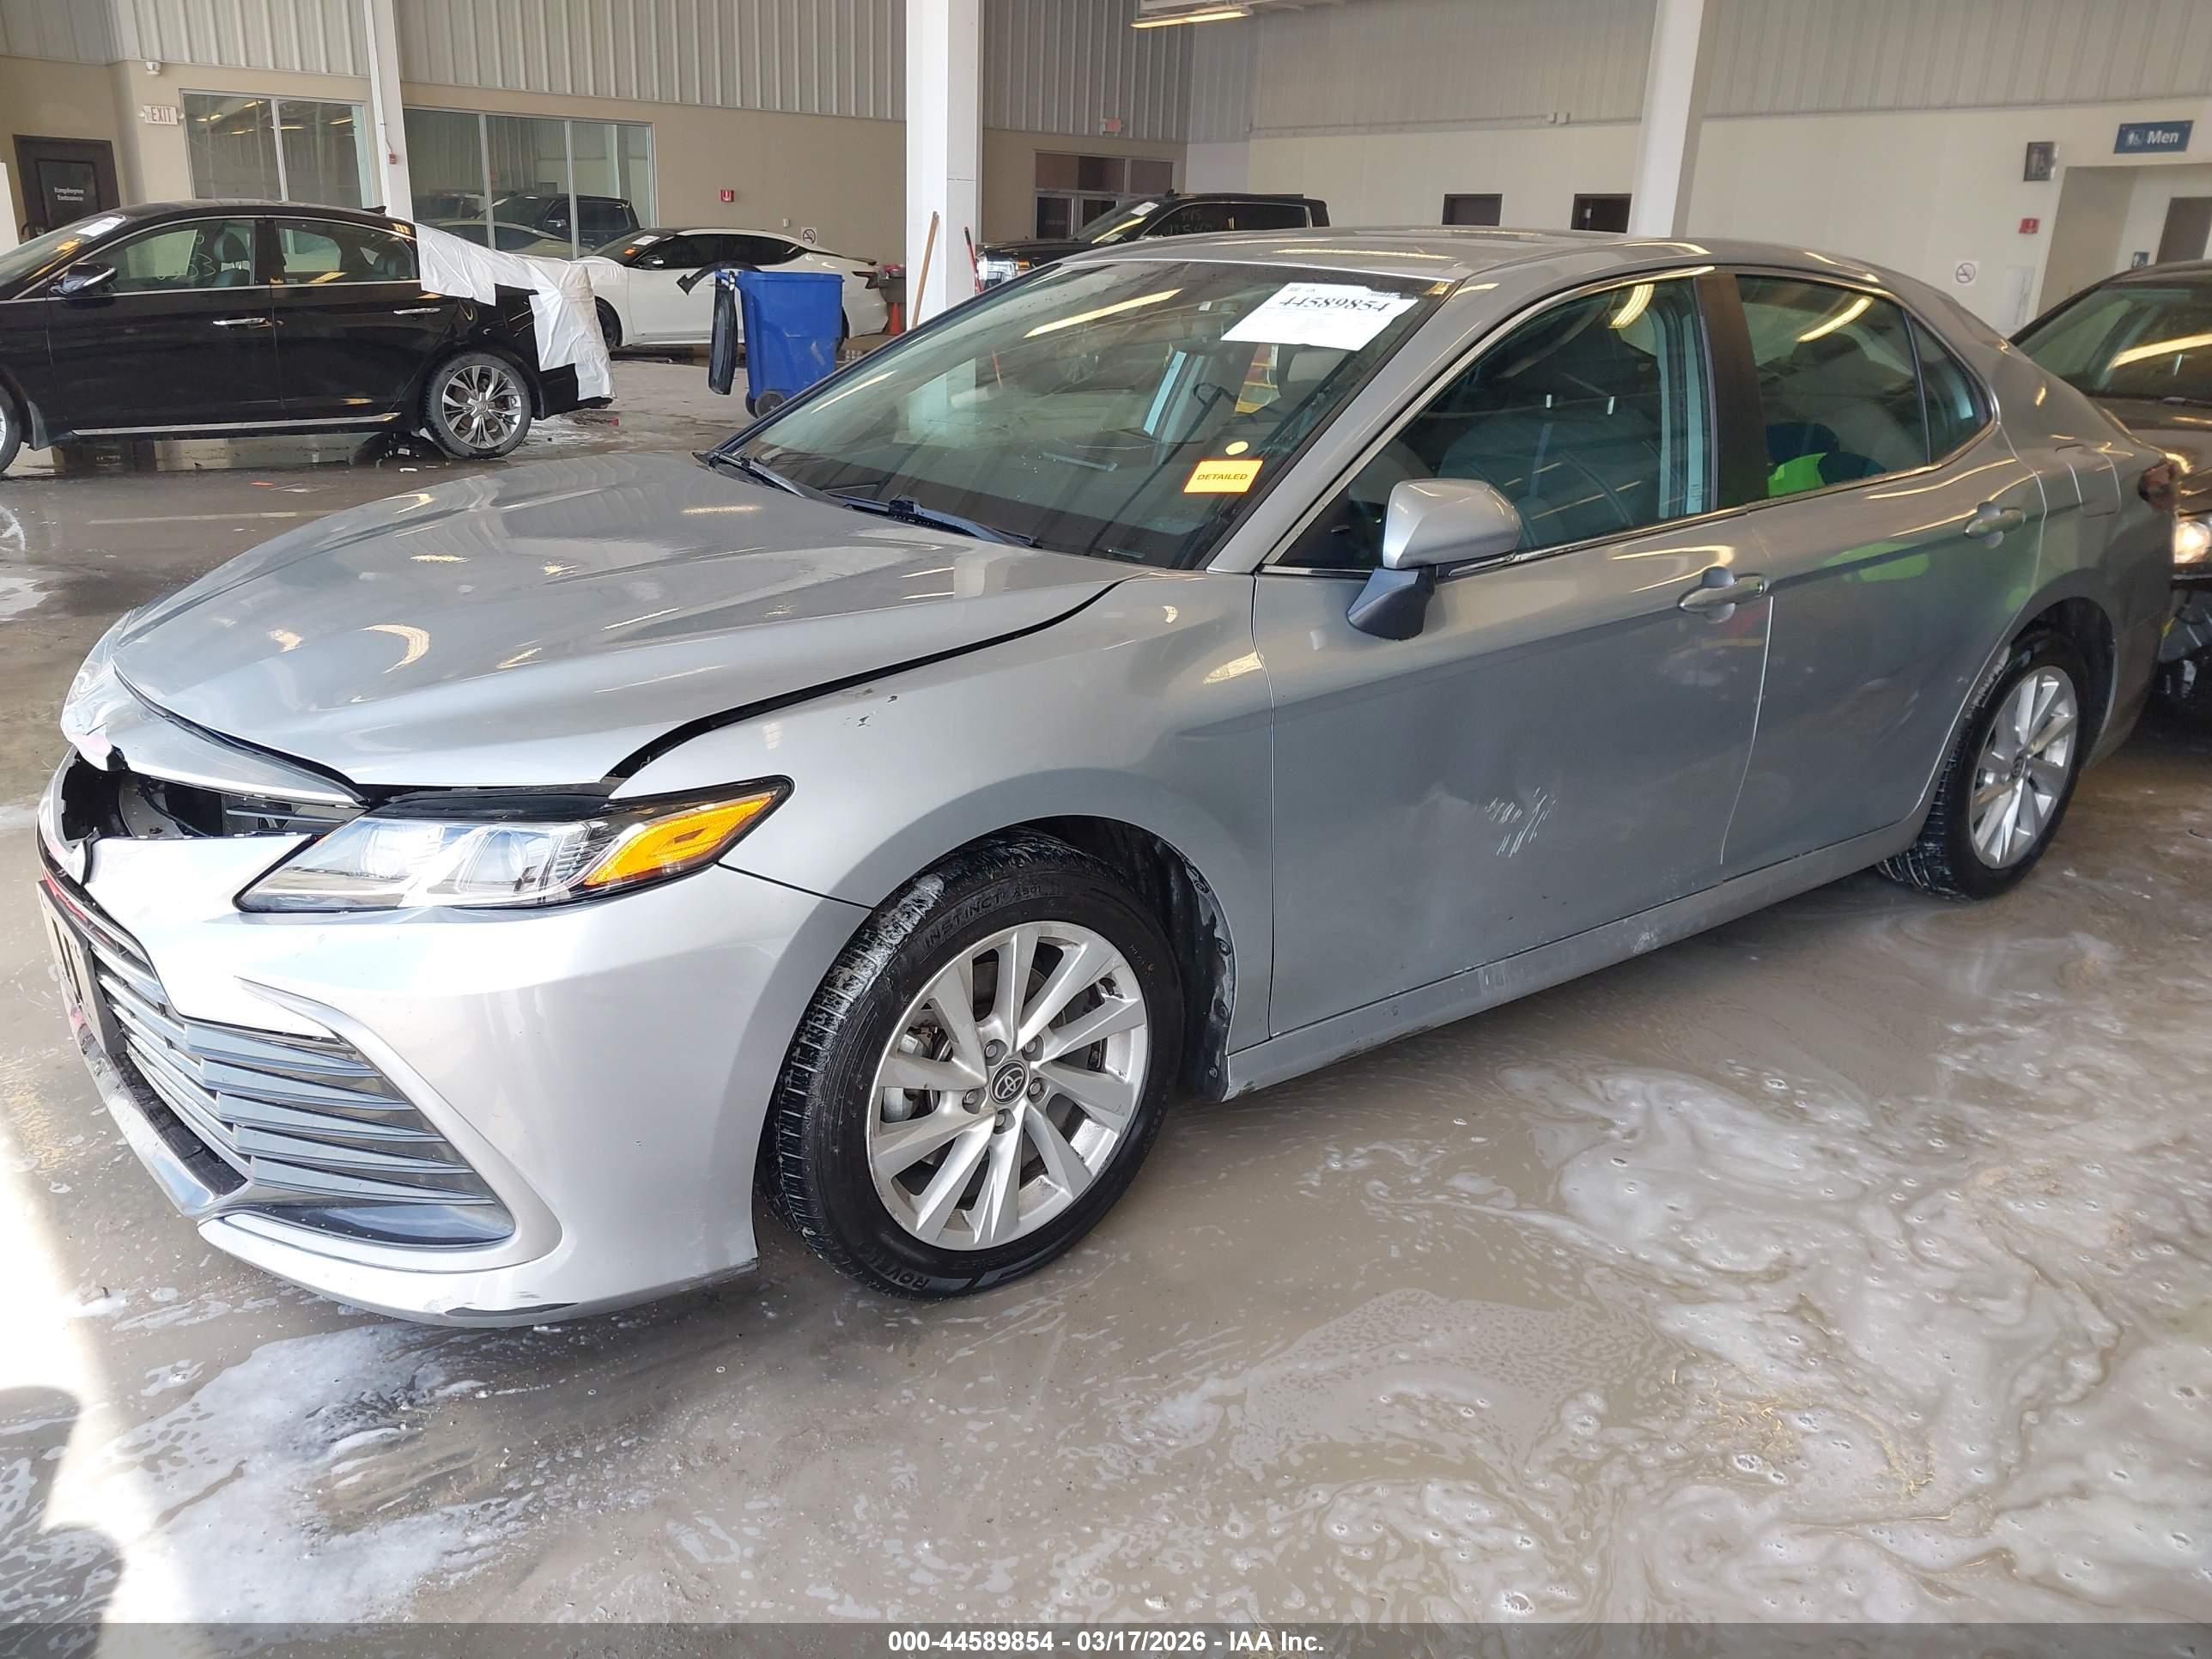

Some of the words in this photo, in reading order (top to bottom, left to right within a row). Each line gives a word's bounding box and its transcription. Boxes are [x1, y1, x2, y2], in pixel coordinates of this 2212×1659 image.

[151, 106, 172, 123] EXIT
[2147, 130, 2179, 144] Men
[1279, 295, 1391, 312] 44589854
